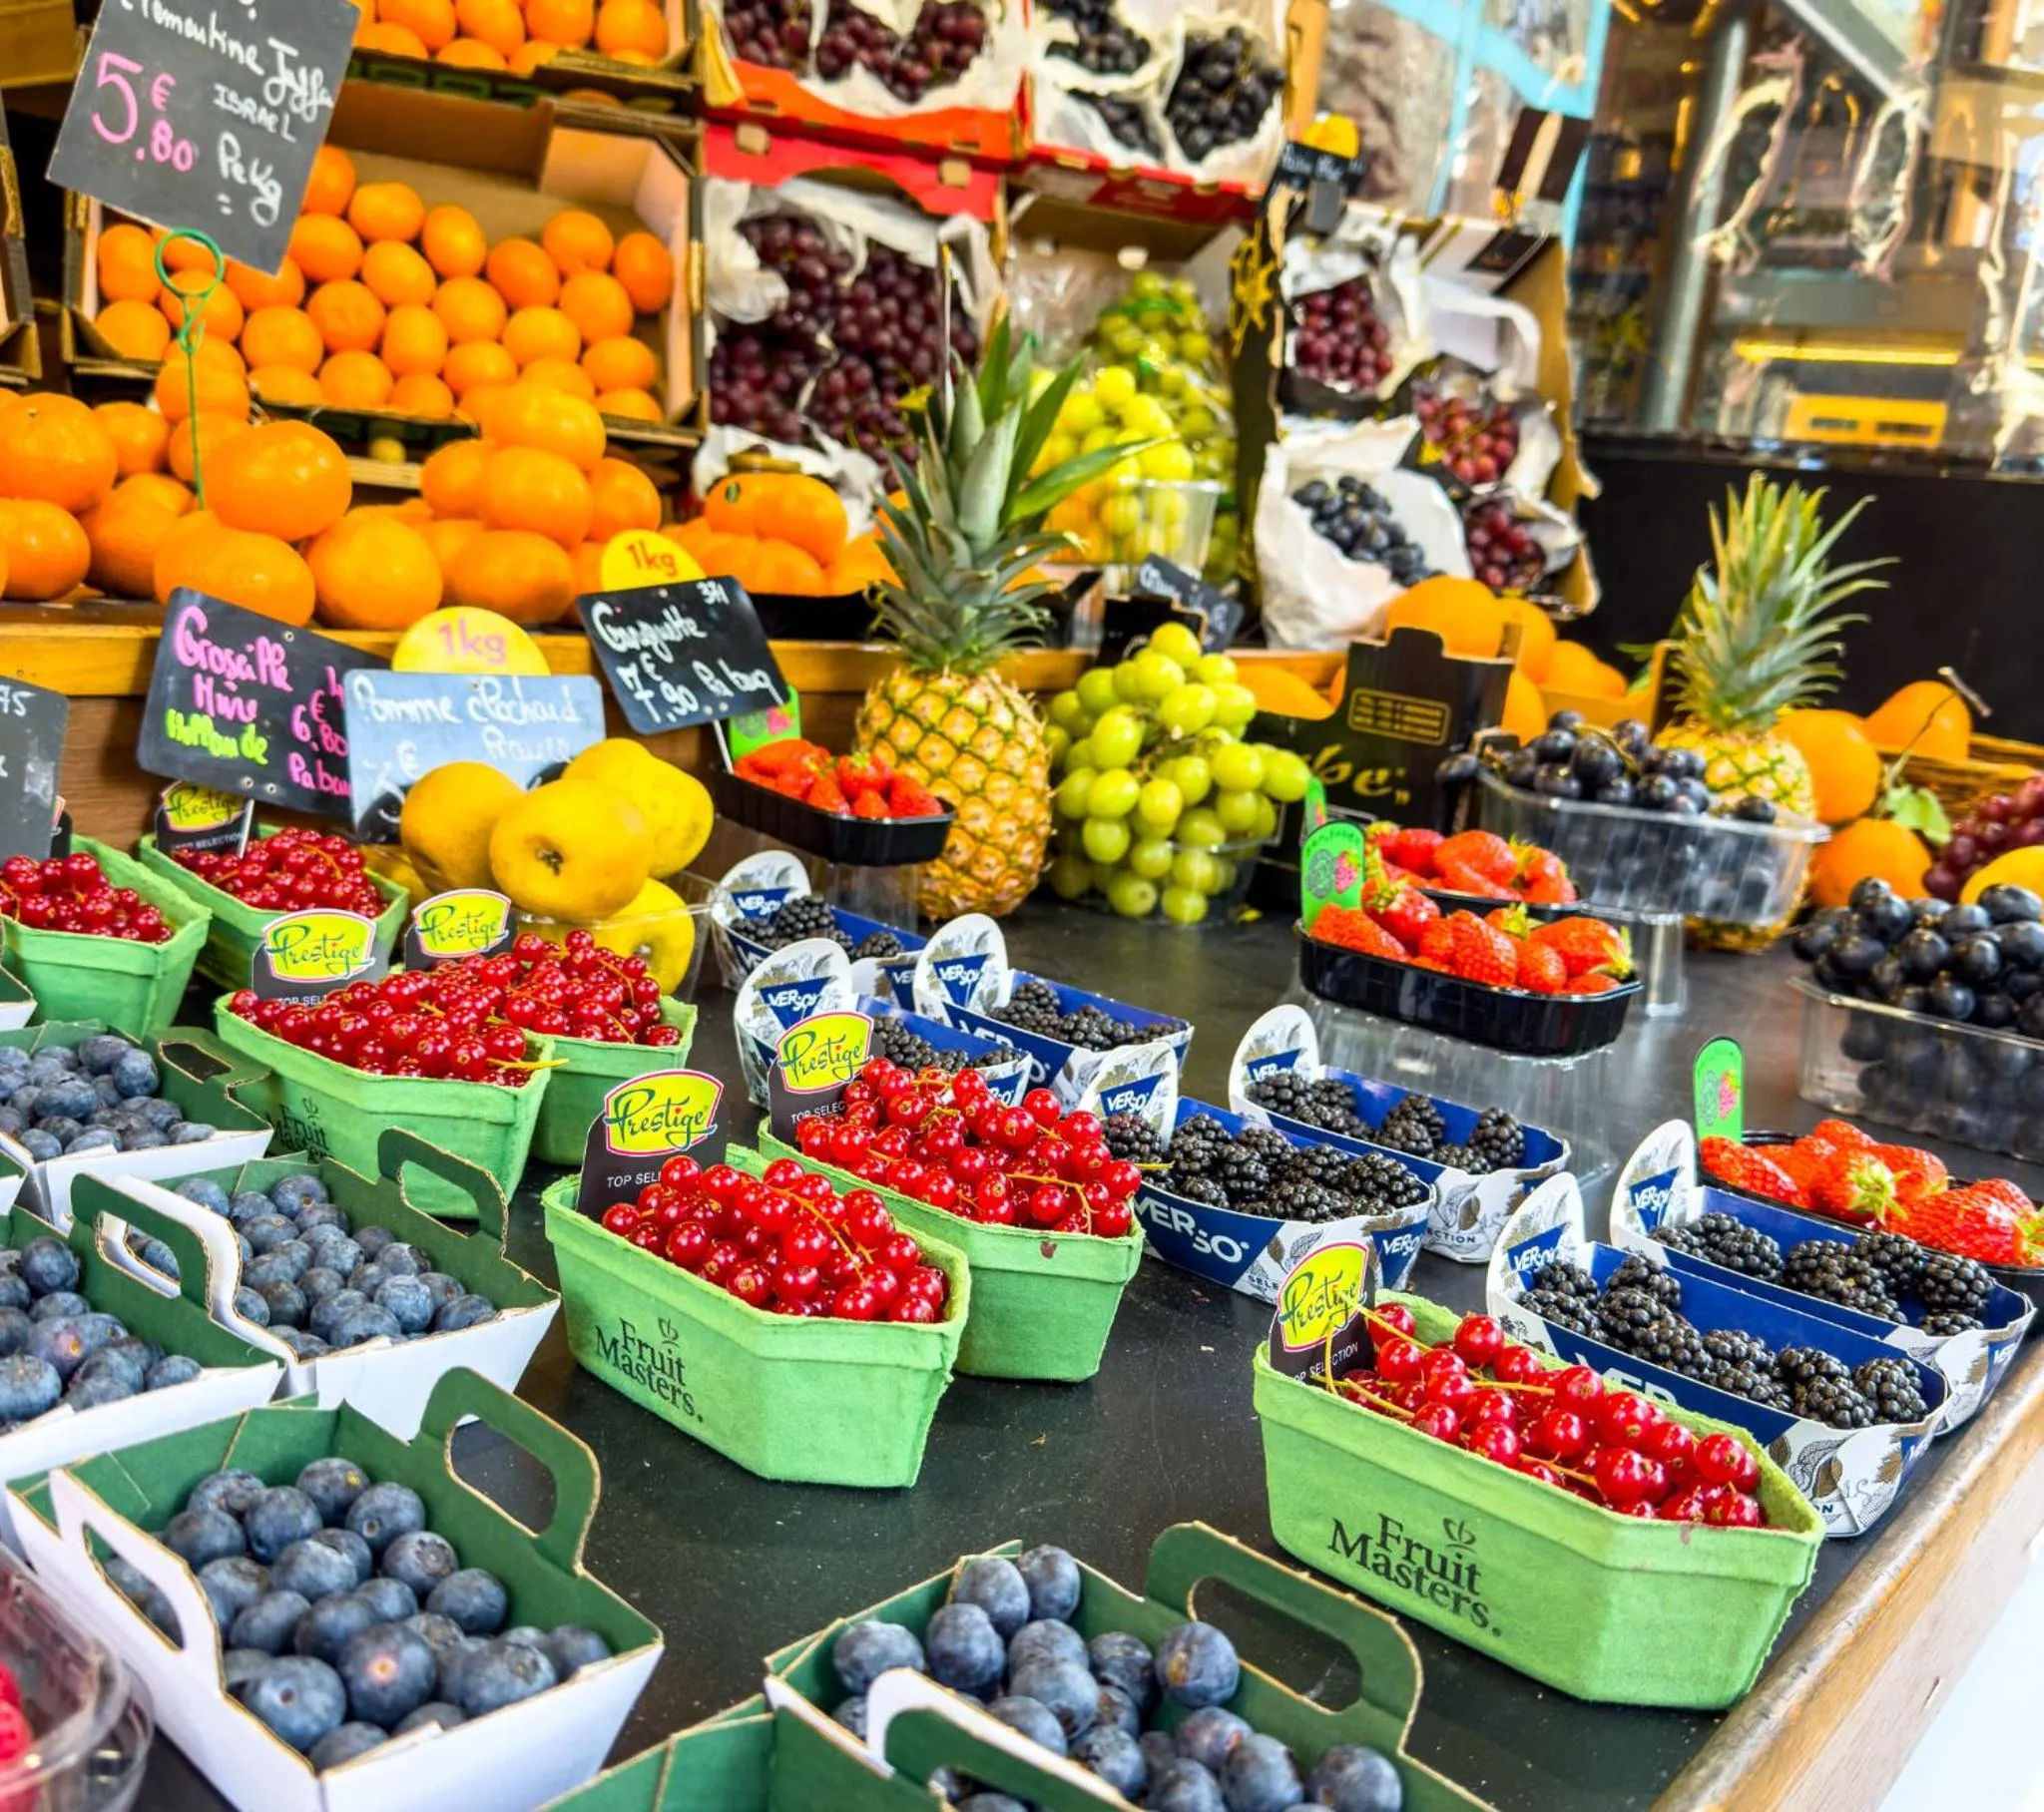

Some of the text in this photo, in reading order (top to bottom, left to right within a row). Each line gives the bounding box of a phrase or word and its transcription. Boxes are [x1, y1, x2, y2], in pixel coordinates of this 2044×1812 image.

[213, 82, 297, 144] ISRAEL
[626, 538, 679, 578] 1kg
[438, 618, 508, 667] 1kg
[352, 674, 464, 724] Pomme
[264, 924, 376, 979] Prestige
[414, 905, 510, 952] Prestige
[777, 1030, 874, 1083] Prestige
[603, 1088, 717, 1151] Prestige
[1107, 1091, 1150, 1116] VERSO
[607, 1172, 632, 1188] TOP
[1278, 1269, 1367, 1338] Prestige
[619, 1317, 687, 1387] Fruit
[1374, 1513, 1483, 1596] Fruit
